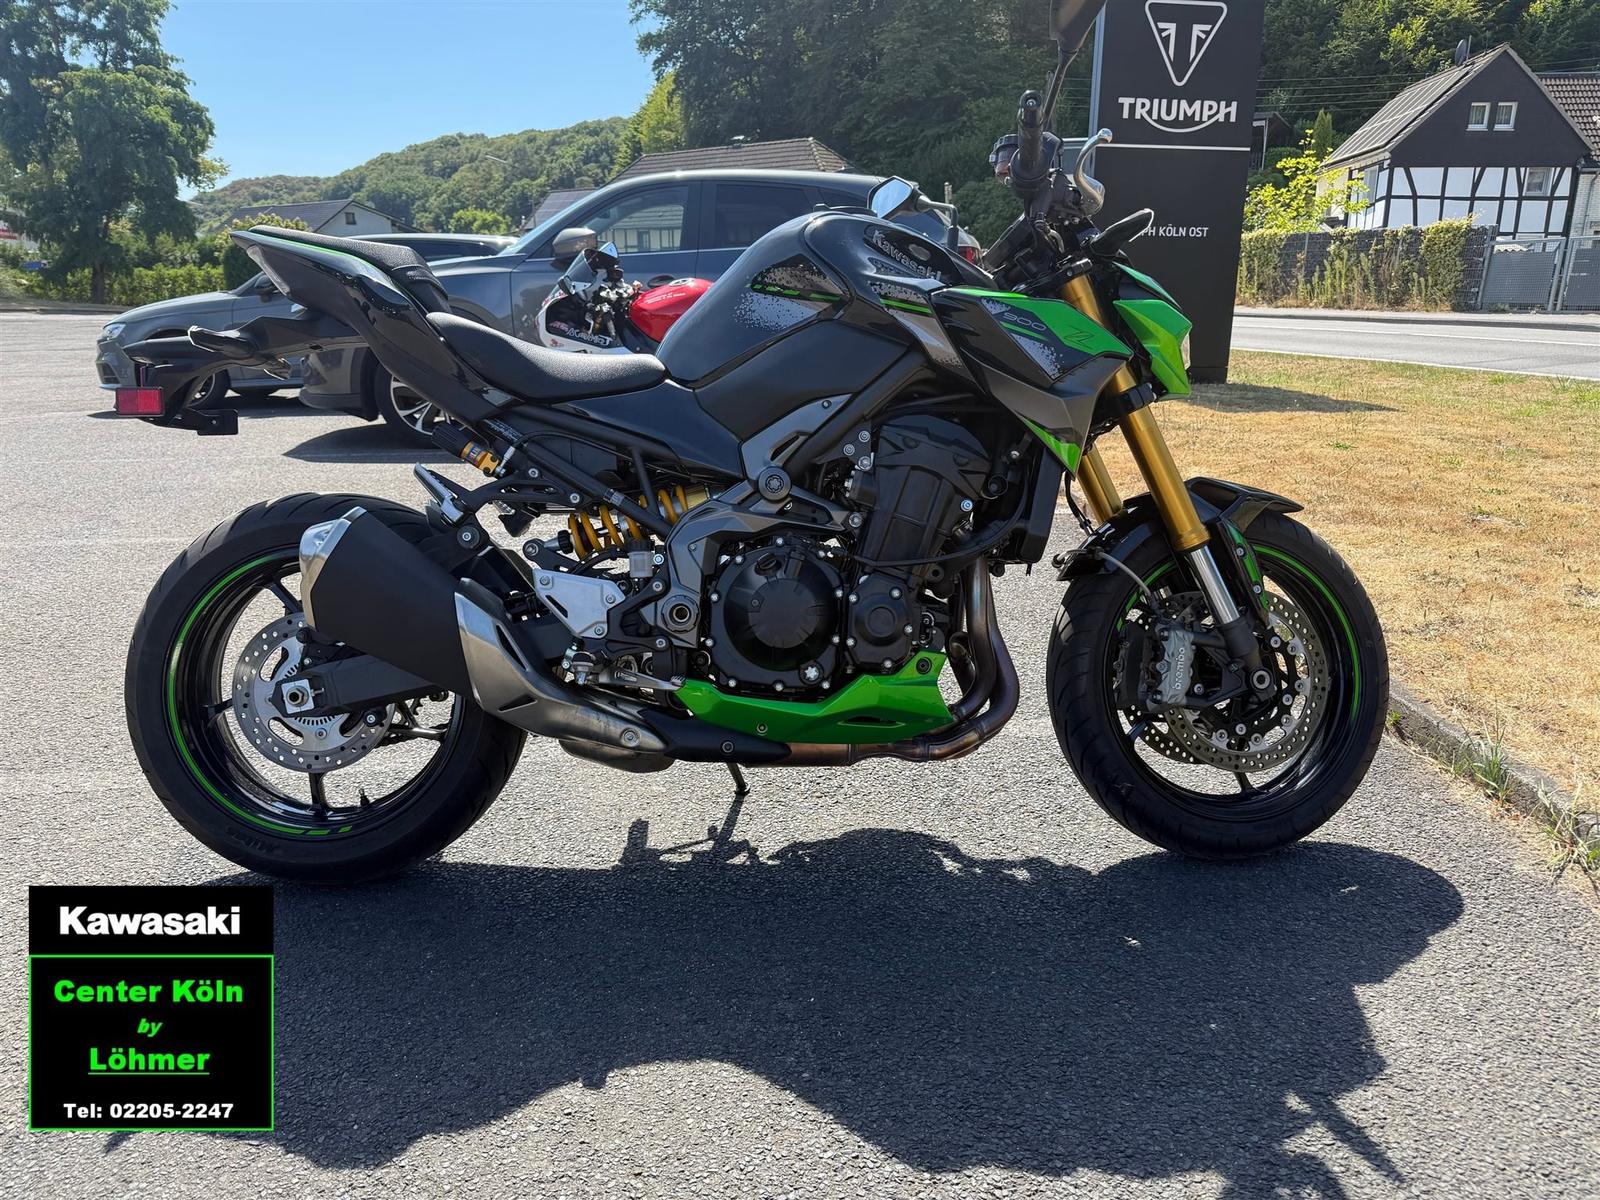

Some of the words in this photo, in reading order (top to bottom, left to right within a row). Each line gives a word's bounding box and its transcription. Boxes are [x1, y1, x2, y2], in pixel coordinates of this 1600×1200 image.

[1118, 97, 1238, 132] TRIUMPH
[1158, 224, 1186, 237] KÖLN
[1188, 227, 1209, 238] OST
[871, 229, 942, 281] Kawasaki
[1003, 313, 1047, 331] 900
[1171, 647, 1186, 690] brembo
